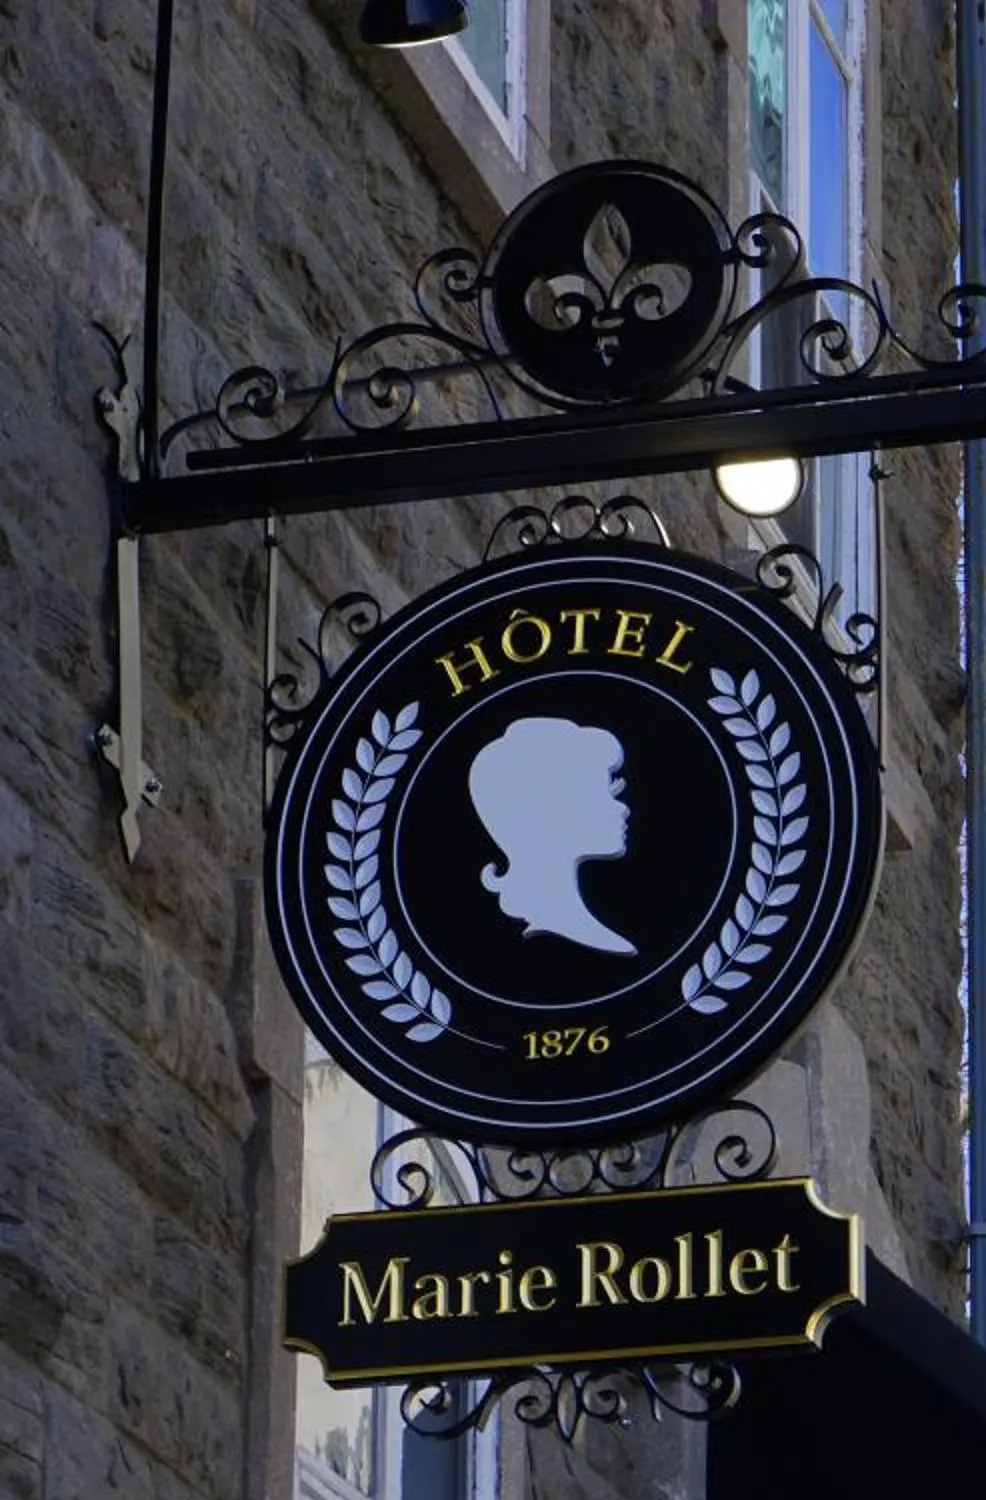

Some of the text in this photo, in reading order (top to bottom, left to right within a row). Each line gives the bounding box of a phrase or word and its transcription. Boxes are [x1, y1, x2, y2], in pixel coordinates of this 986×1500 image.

[435, 607, 697, 698] HÔTEL
[522, 1026, 612, 1062] 1876
[337, 1230, 801, 1327] Marie Rollet
